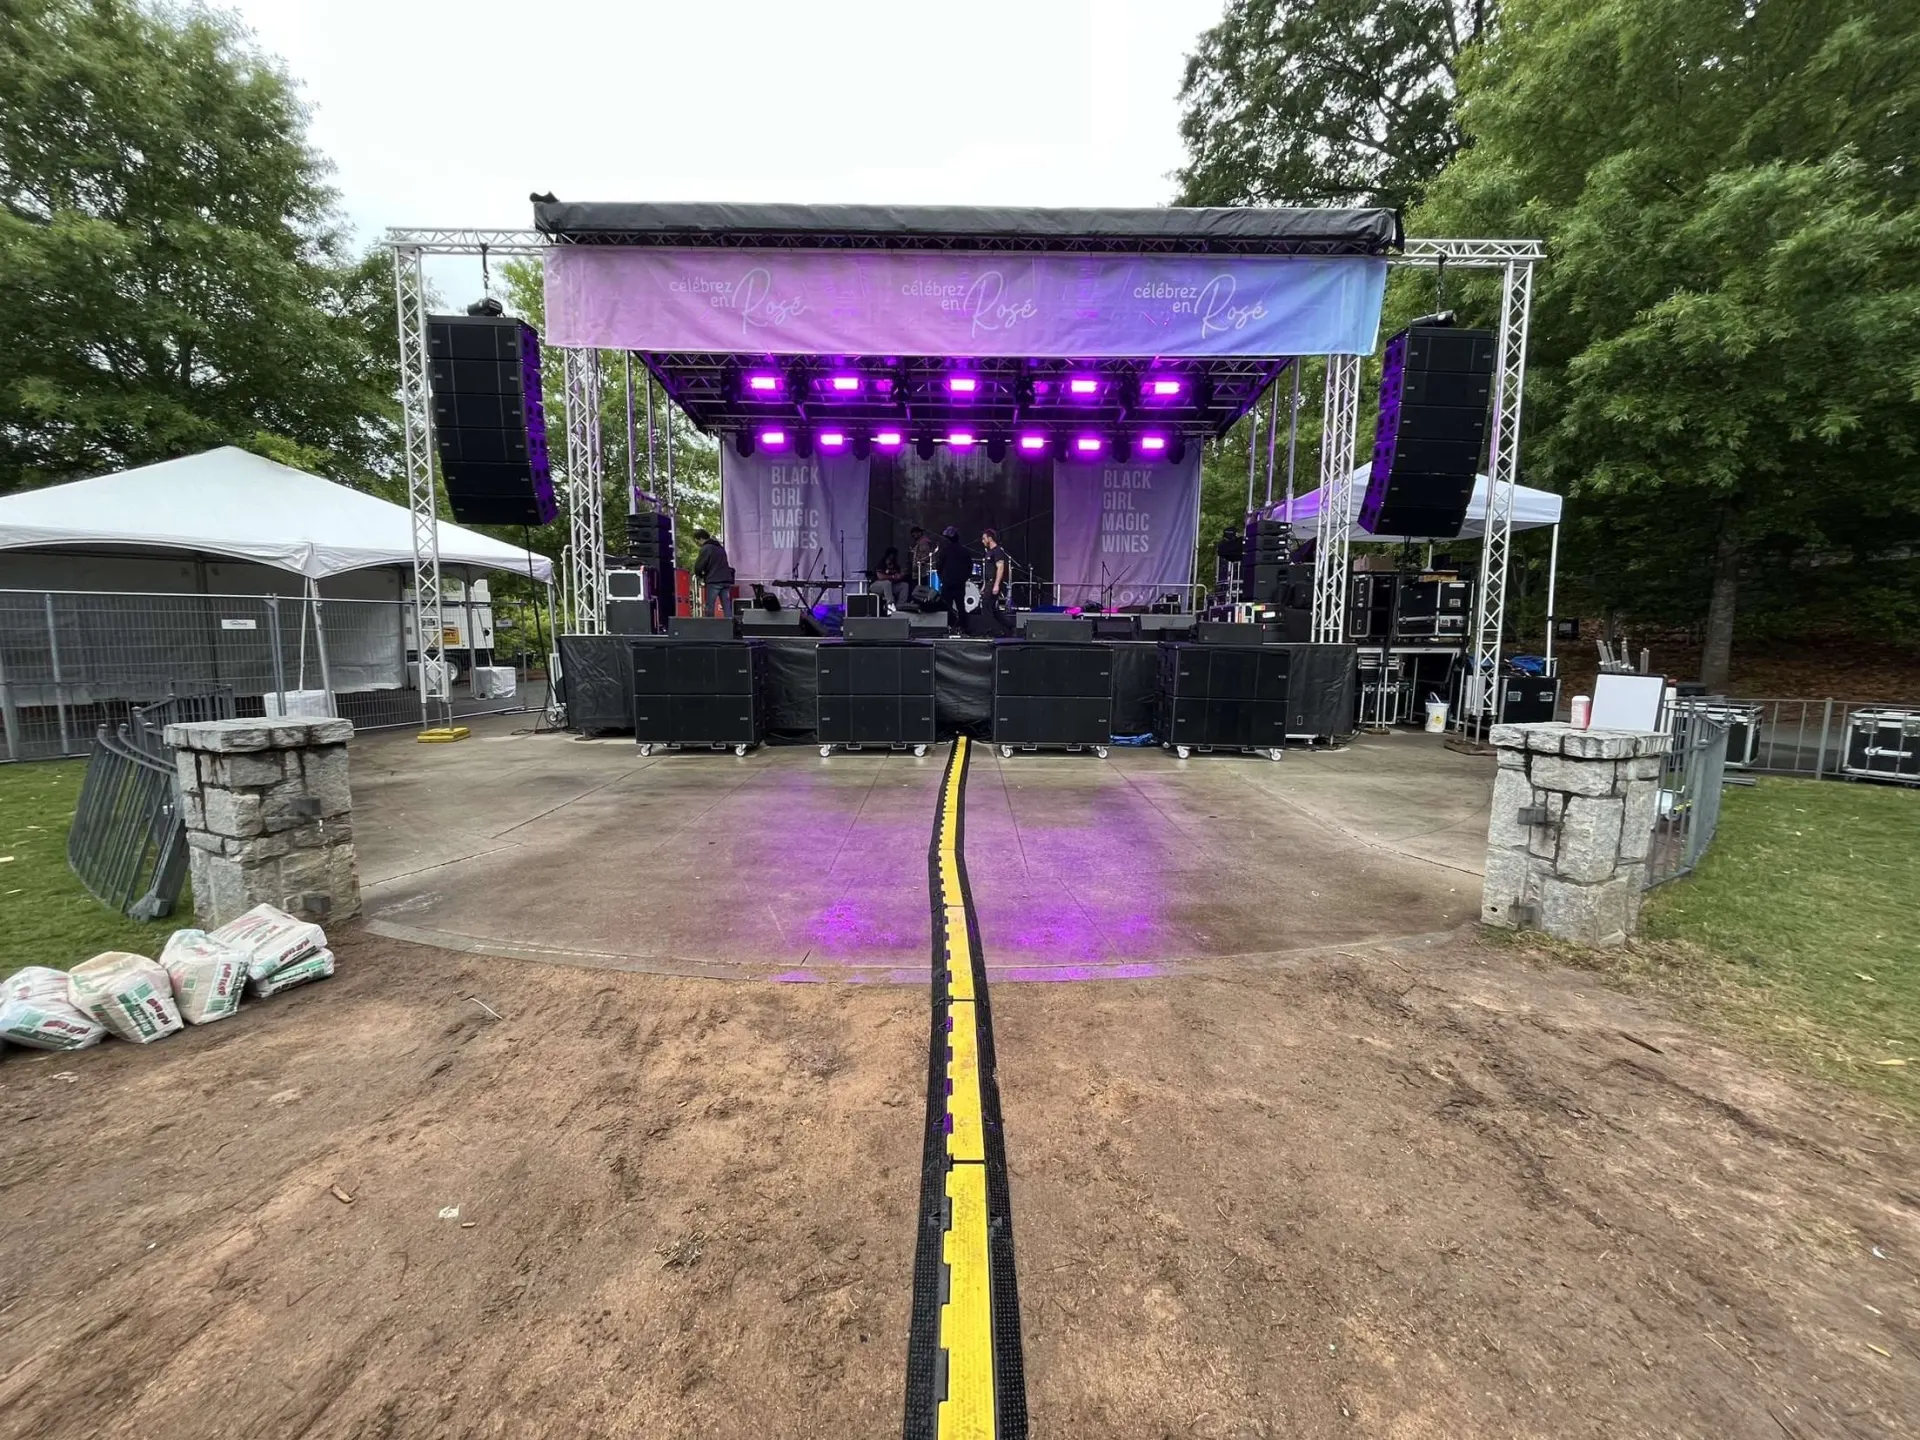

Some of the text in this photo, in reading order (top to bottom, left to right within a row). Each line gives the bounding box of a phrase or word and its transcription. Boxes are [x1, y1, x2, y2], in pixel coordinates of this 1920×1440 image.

[669, 275, 733, 294] célébrez
[901, 279, 965, 297] célébrez
[1133, 281, 1199, 299] célébrez
[710, 267, 809, 335] en Rosé
[941, 270, 1038, 339] en Rosé
[1172, 273, 1269, 340] en Rosé
[771, 465, 819, 485] BLACK
[1103, 469, 1153, 489] BLACK
[771, 487, 804, 506] GIRL
[1103, 491, 1136, 510] GIRL
[771, 508, 819, 528] MAGIC
[1101, 512, 1150, 532] MAGIC
[772, 530, 818, 550] WINES
[1101, 534, 1150, 553] WINES
